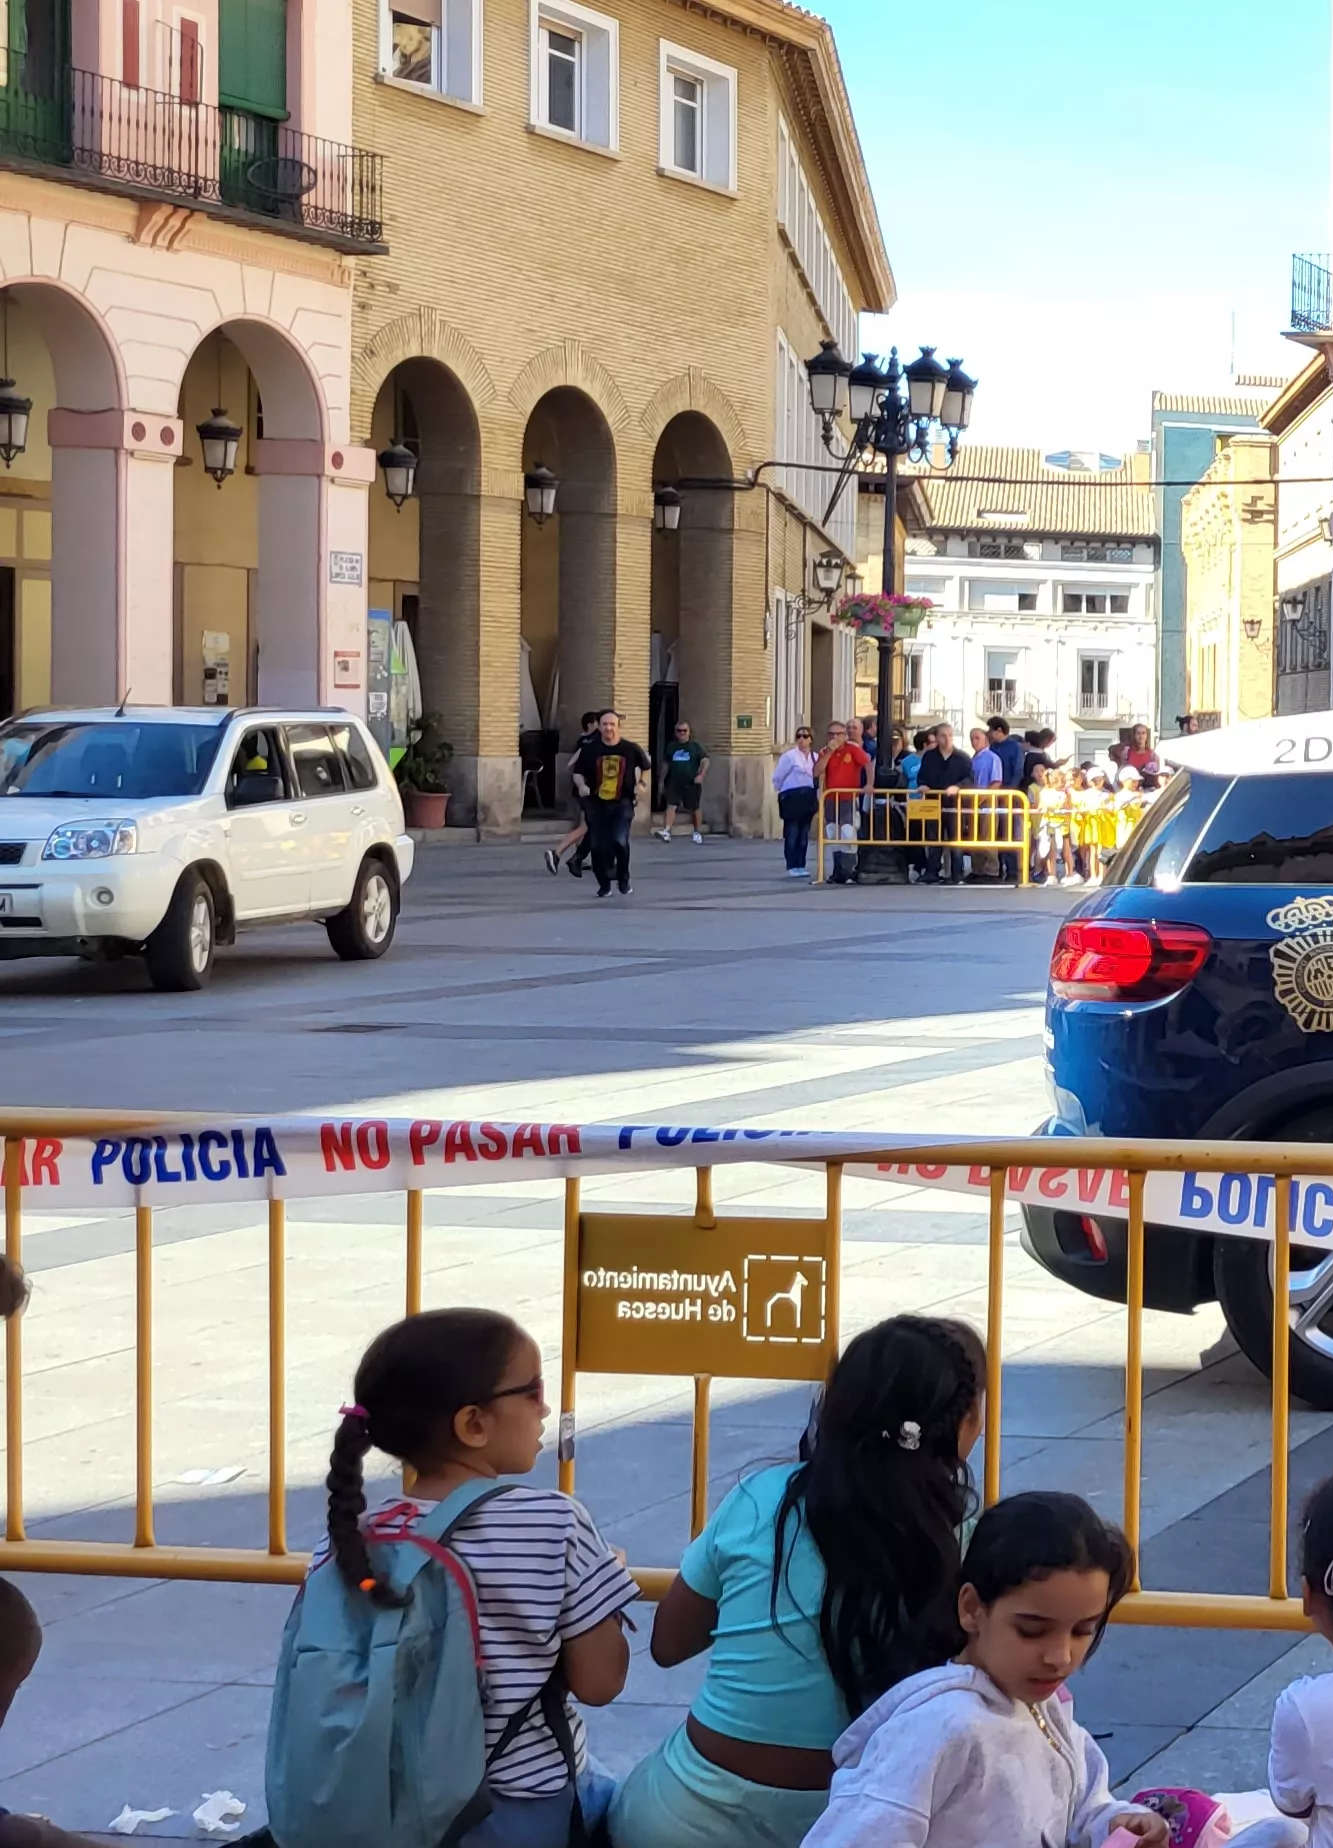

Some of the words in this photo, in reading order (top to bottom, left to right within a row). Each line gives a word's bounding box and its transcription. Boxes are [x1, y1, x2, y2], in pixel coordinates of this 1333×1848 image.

[92, 1127, 287, 1186] POLICIA
[320, 1120, 391, 1172] NO
[408, 1120, 582, 1166] PASAR
